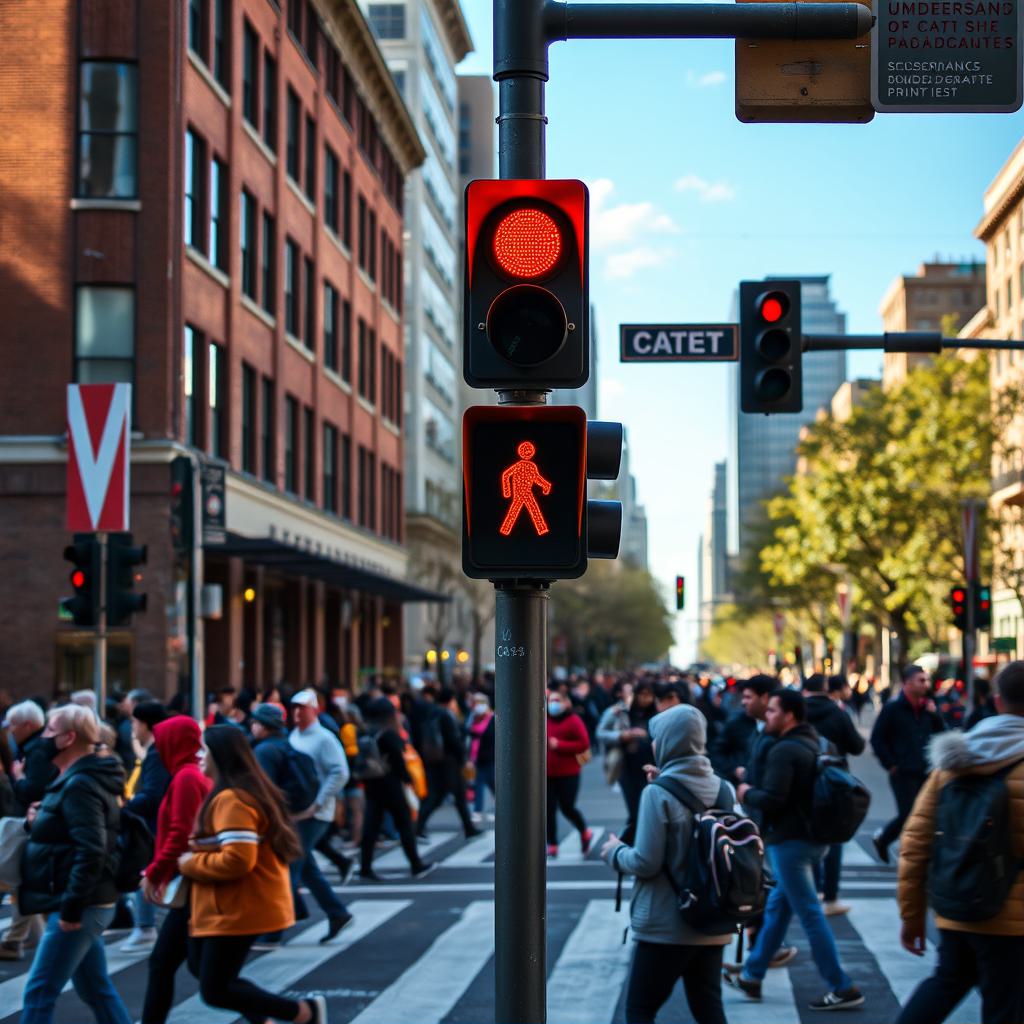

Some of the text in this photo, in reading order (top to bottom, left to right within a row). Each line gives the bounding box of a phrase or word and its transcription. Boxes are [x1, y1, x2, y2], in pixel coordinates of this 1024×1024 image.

[888, 20, 910, 33] OF
[965, 20, 999, 33] SHE
[632, 330, 724, 354] CATET
